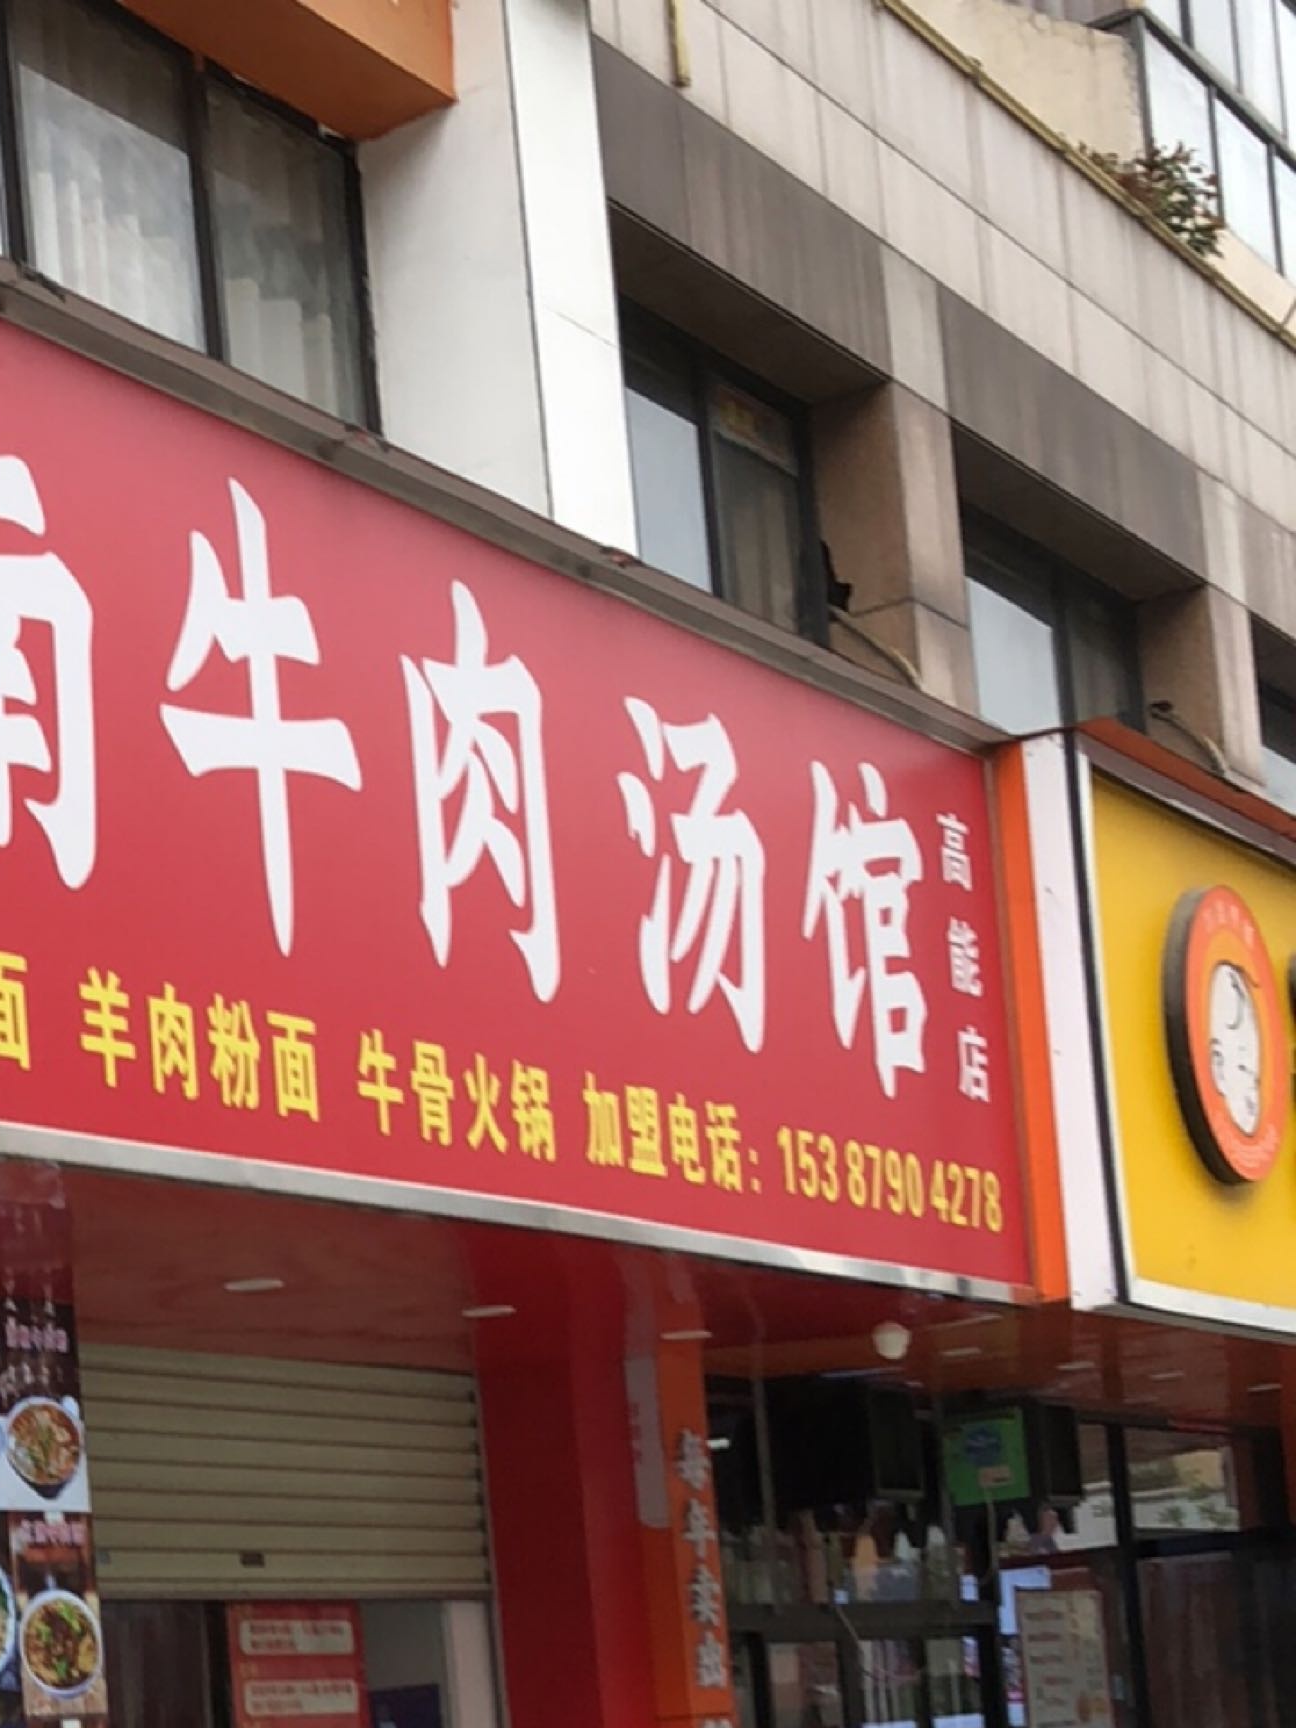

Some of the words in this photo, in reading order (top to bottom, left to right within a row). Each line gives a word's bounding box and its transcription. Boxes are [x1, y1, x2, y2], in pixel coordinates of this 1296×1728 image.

[79, 970, 320, 1123] 羊肉粉面
[357, 1029, 556, 1162] 牛骨火锅
[936, 812, 990, 1103] 高能店
